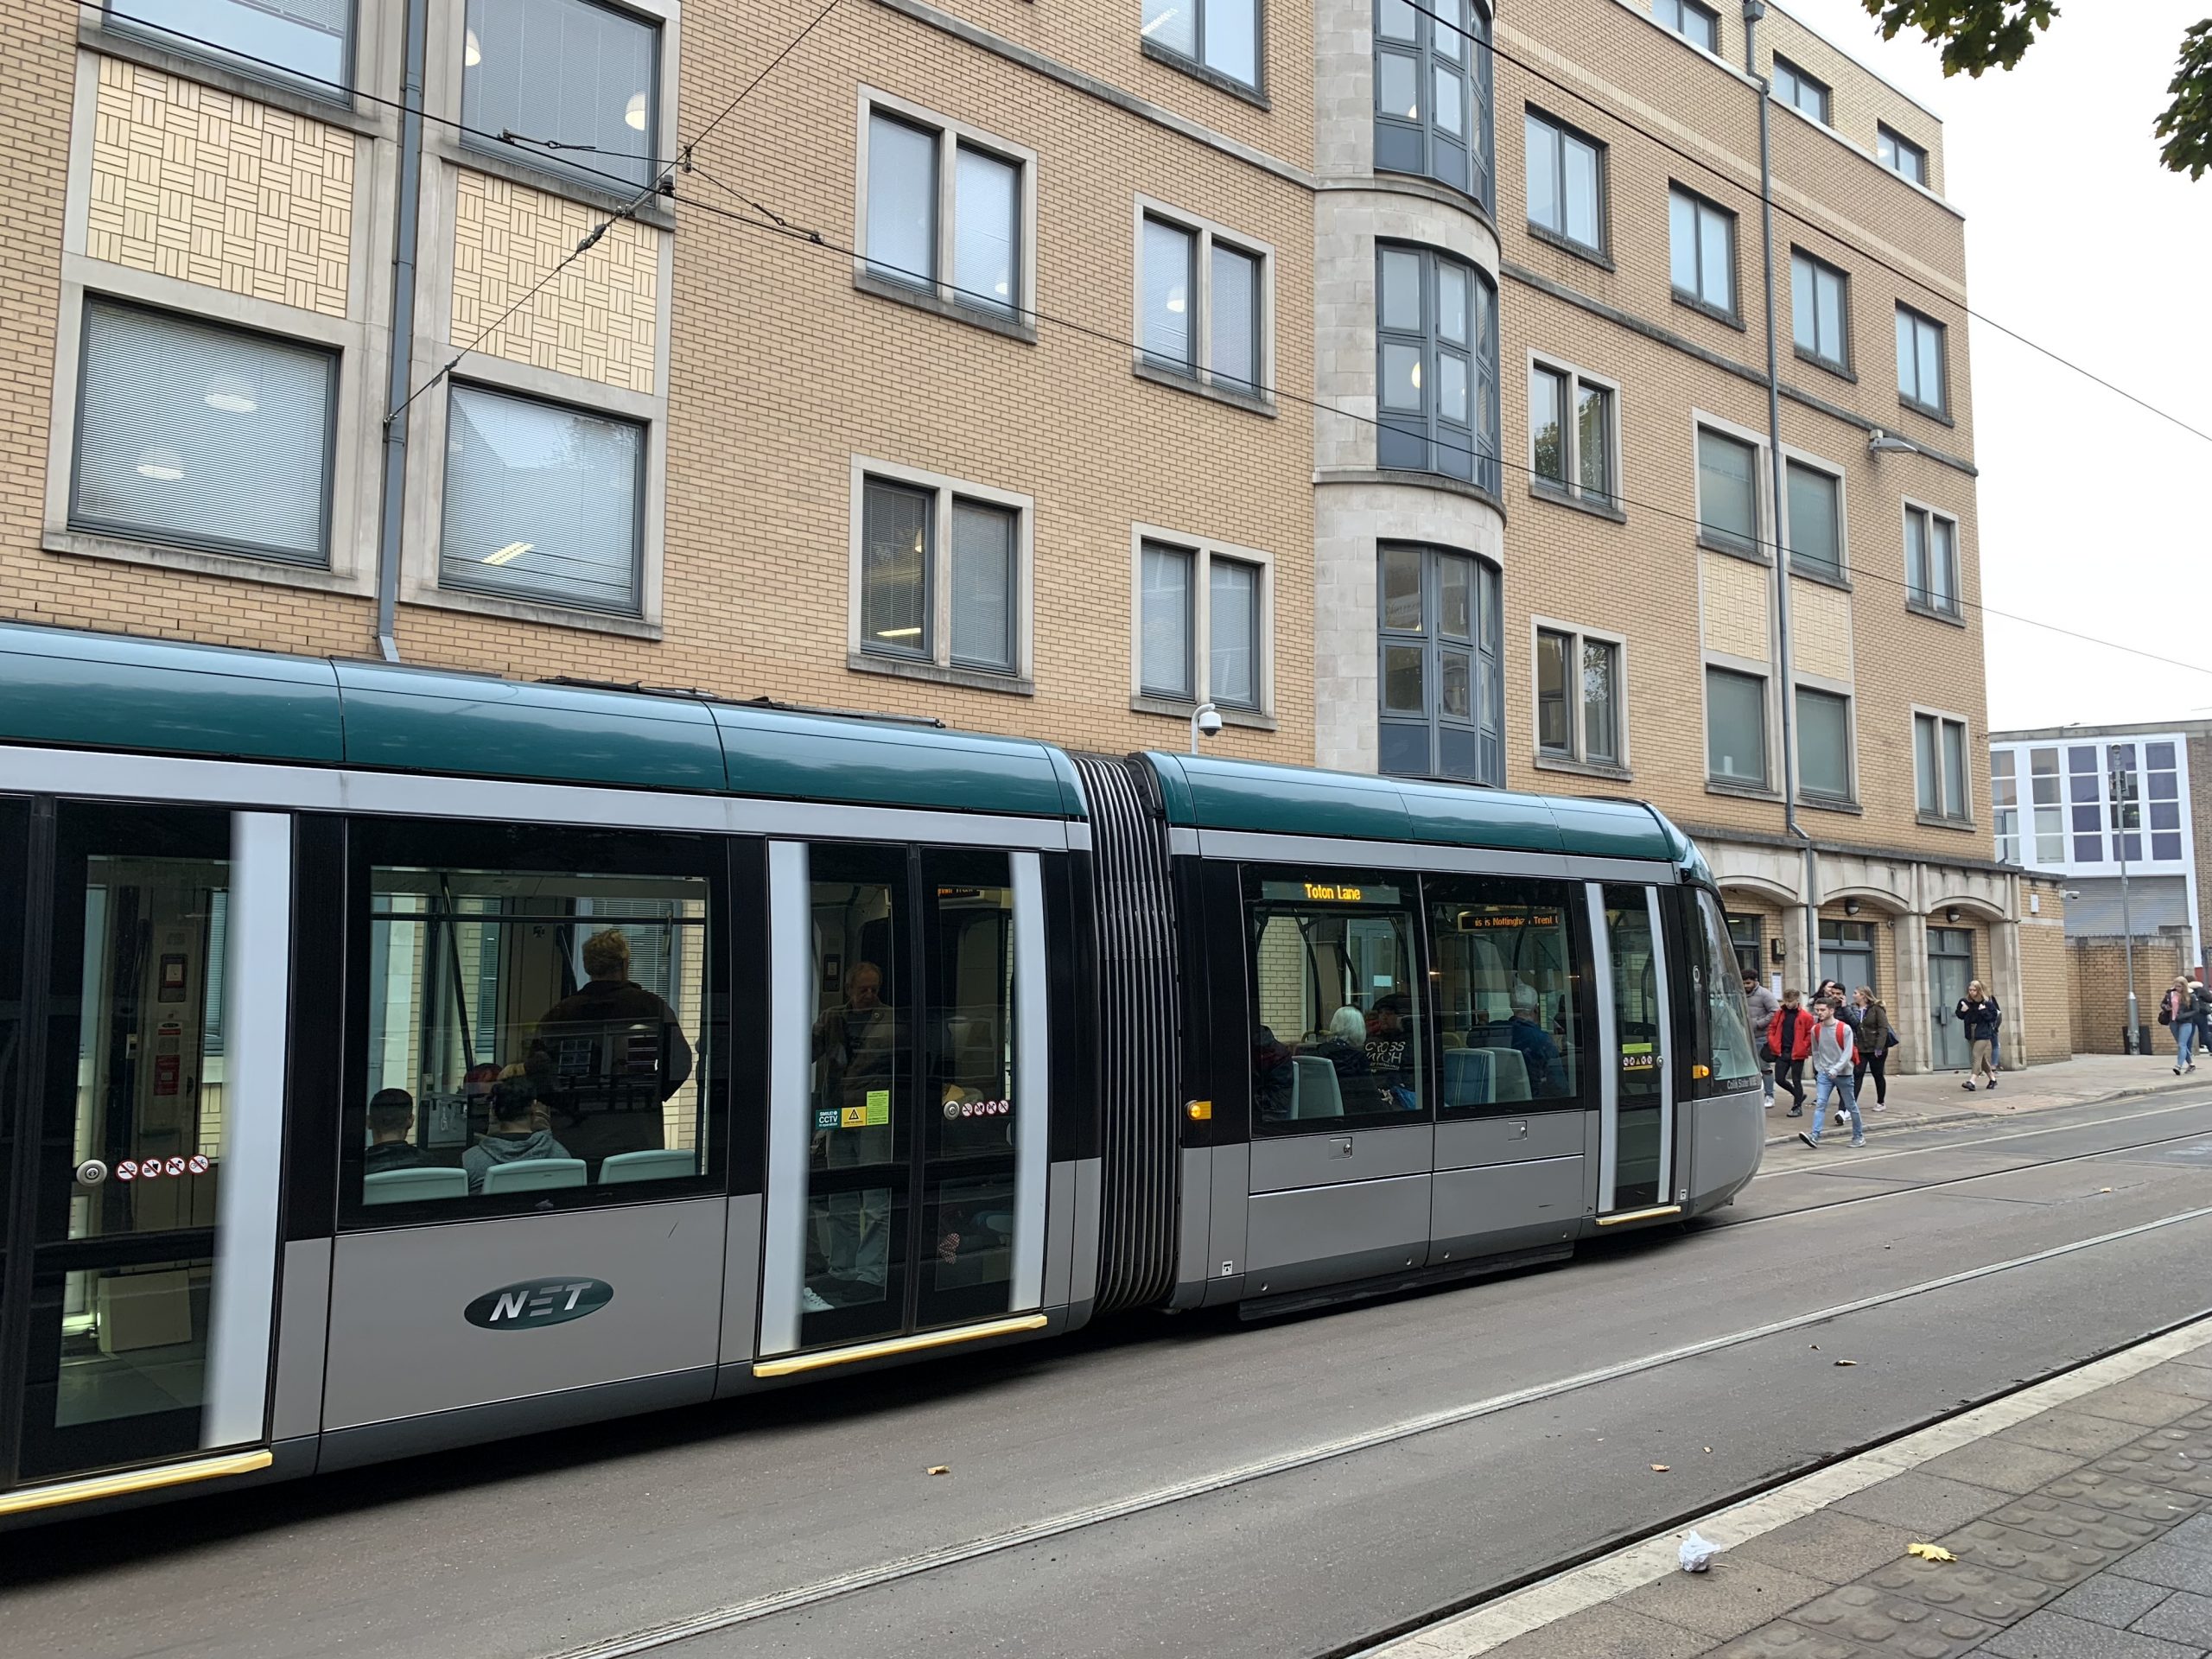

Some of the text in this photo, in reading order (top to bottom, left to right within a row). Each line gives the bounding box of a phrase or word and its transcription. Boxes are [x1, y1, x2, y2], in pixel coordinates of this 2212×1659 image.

[1304, 883, 1361, 900] Toton Lane
[1364, 1040, 1406, 1053] CROSS
[489, 1281, 594, 1322] NET
